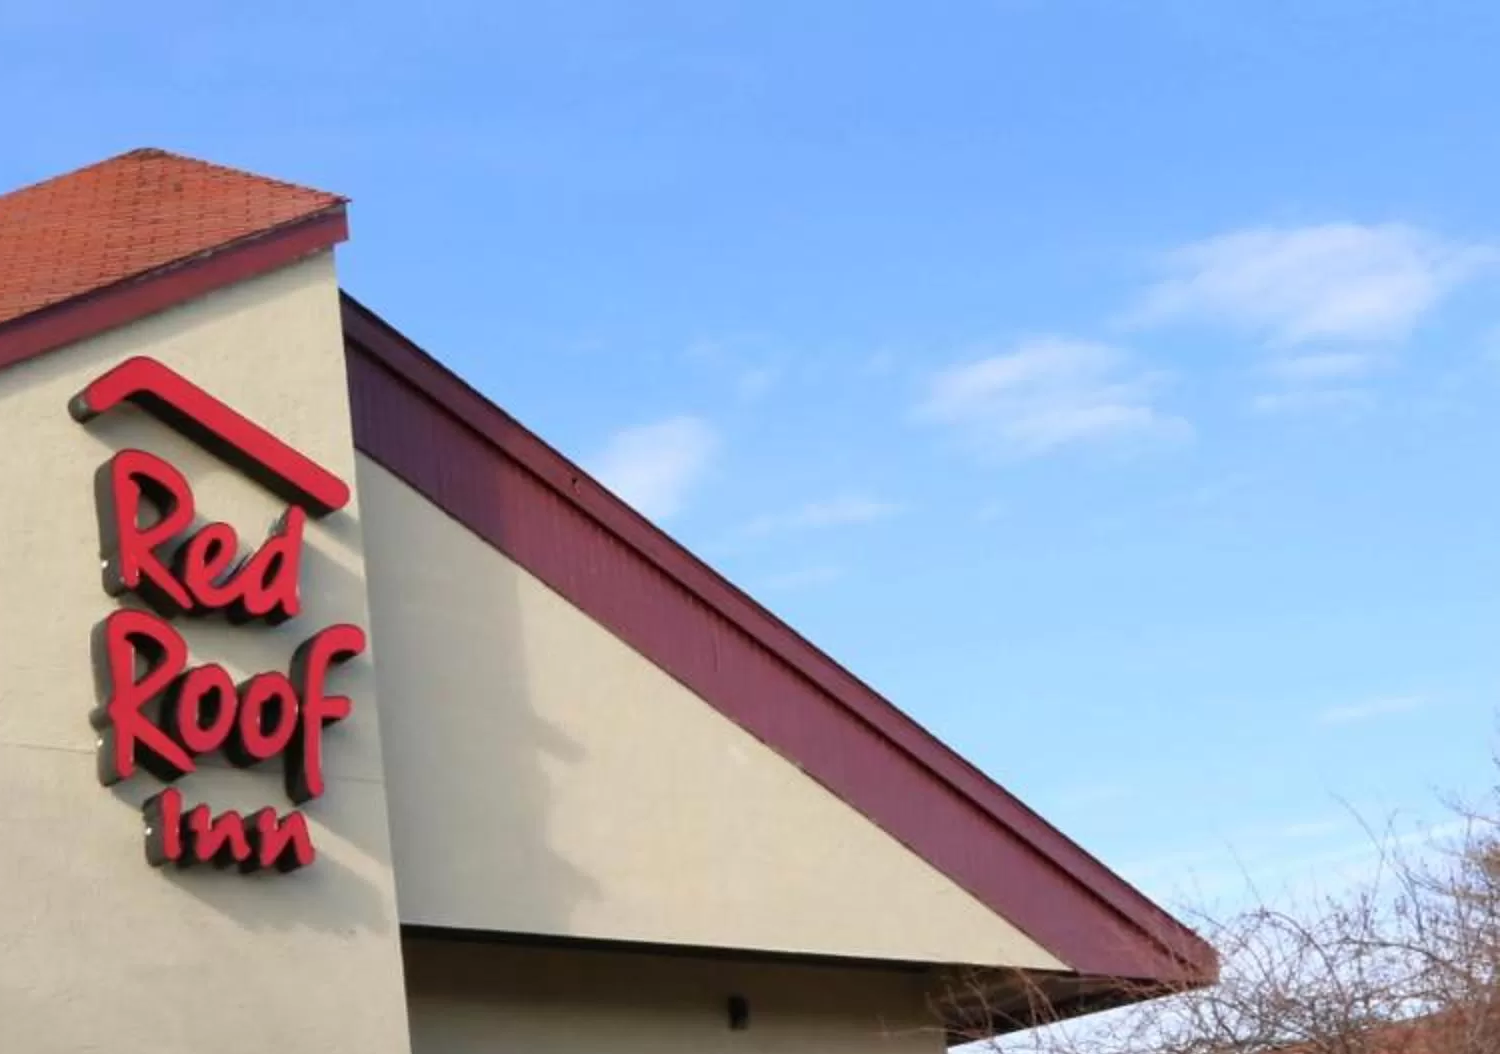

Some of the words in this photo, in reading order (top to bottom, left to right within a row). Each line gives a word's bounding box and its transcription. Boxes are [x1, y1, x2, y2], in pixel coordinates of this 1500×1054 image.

[99, 448, 306, 619] Red
[97, 609, 366, 800] Roof
[147, 787, 316, 866] Inn
